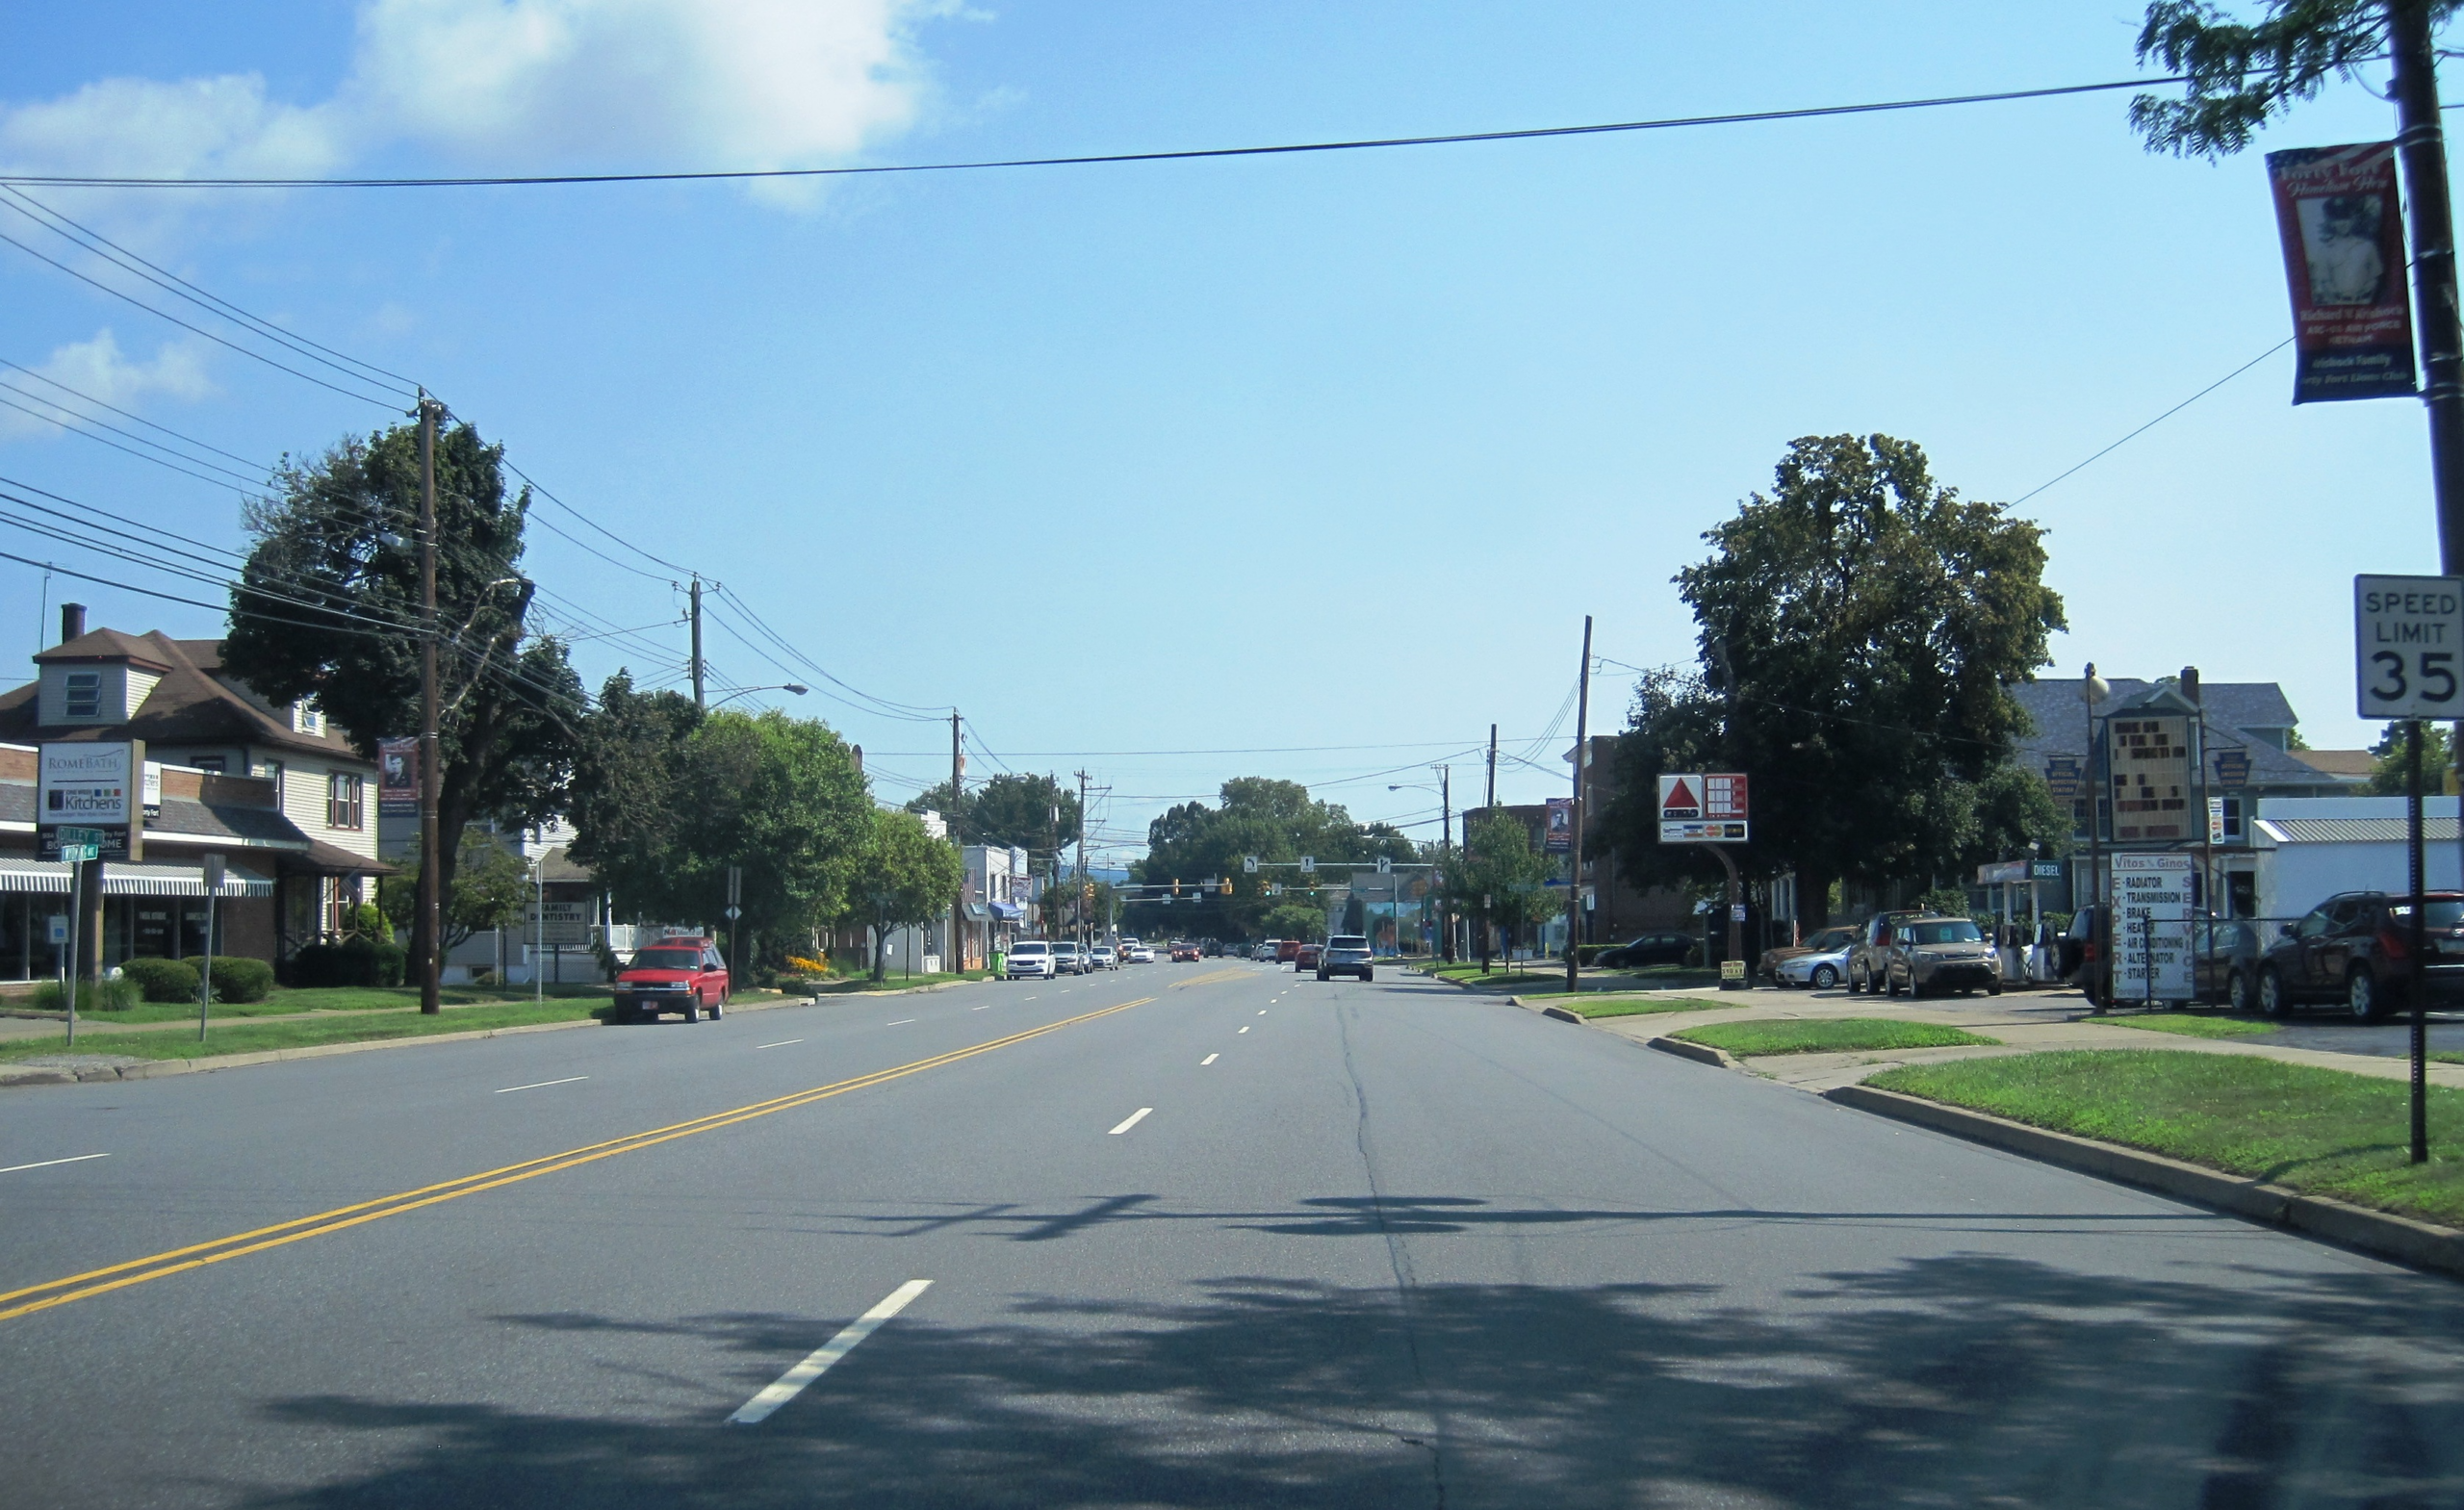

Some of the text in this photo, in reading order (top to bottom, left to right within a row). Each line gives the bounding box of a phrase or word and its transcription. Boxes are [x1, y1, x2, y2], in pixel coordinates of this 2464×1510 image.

[2338, 161, 2378, 177] Fort
[2366, 592, 2456, 615] SPEED
[2376, 622, 2446, 644] LIMIT
[2370, 651, 2456, 704] 35
[65, 795, 122, 811] Kitchens
[60, 829, 90, 842] DILLEY
[2034, 865, 2059, 876] DIESEL
[2126, 877, 2162, 888] RADIATOR
[2127, 891, 2181, 904] TRANSMISSION
[530, 912, 582, 922] DNTISTRY
[2126, 907, 2151, 919] BRAKE
[2139, 936, 2183, 949] CDITIONING
[2127, 952, 2174, 964] ALTENATOR
[2127, 967, 2160, 980] STARER
